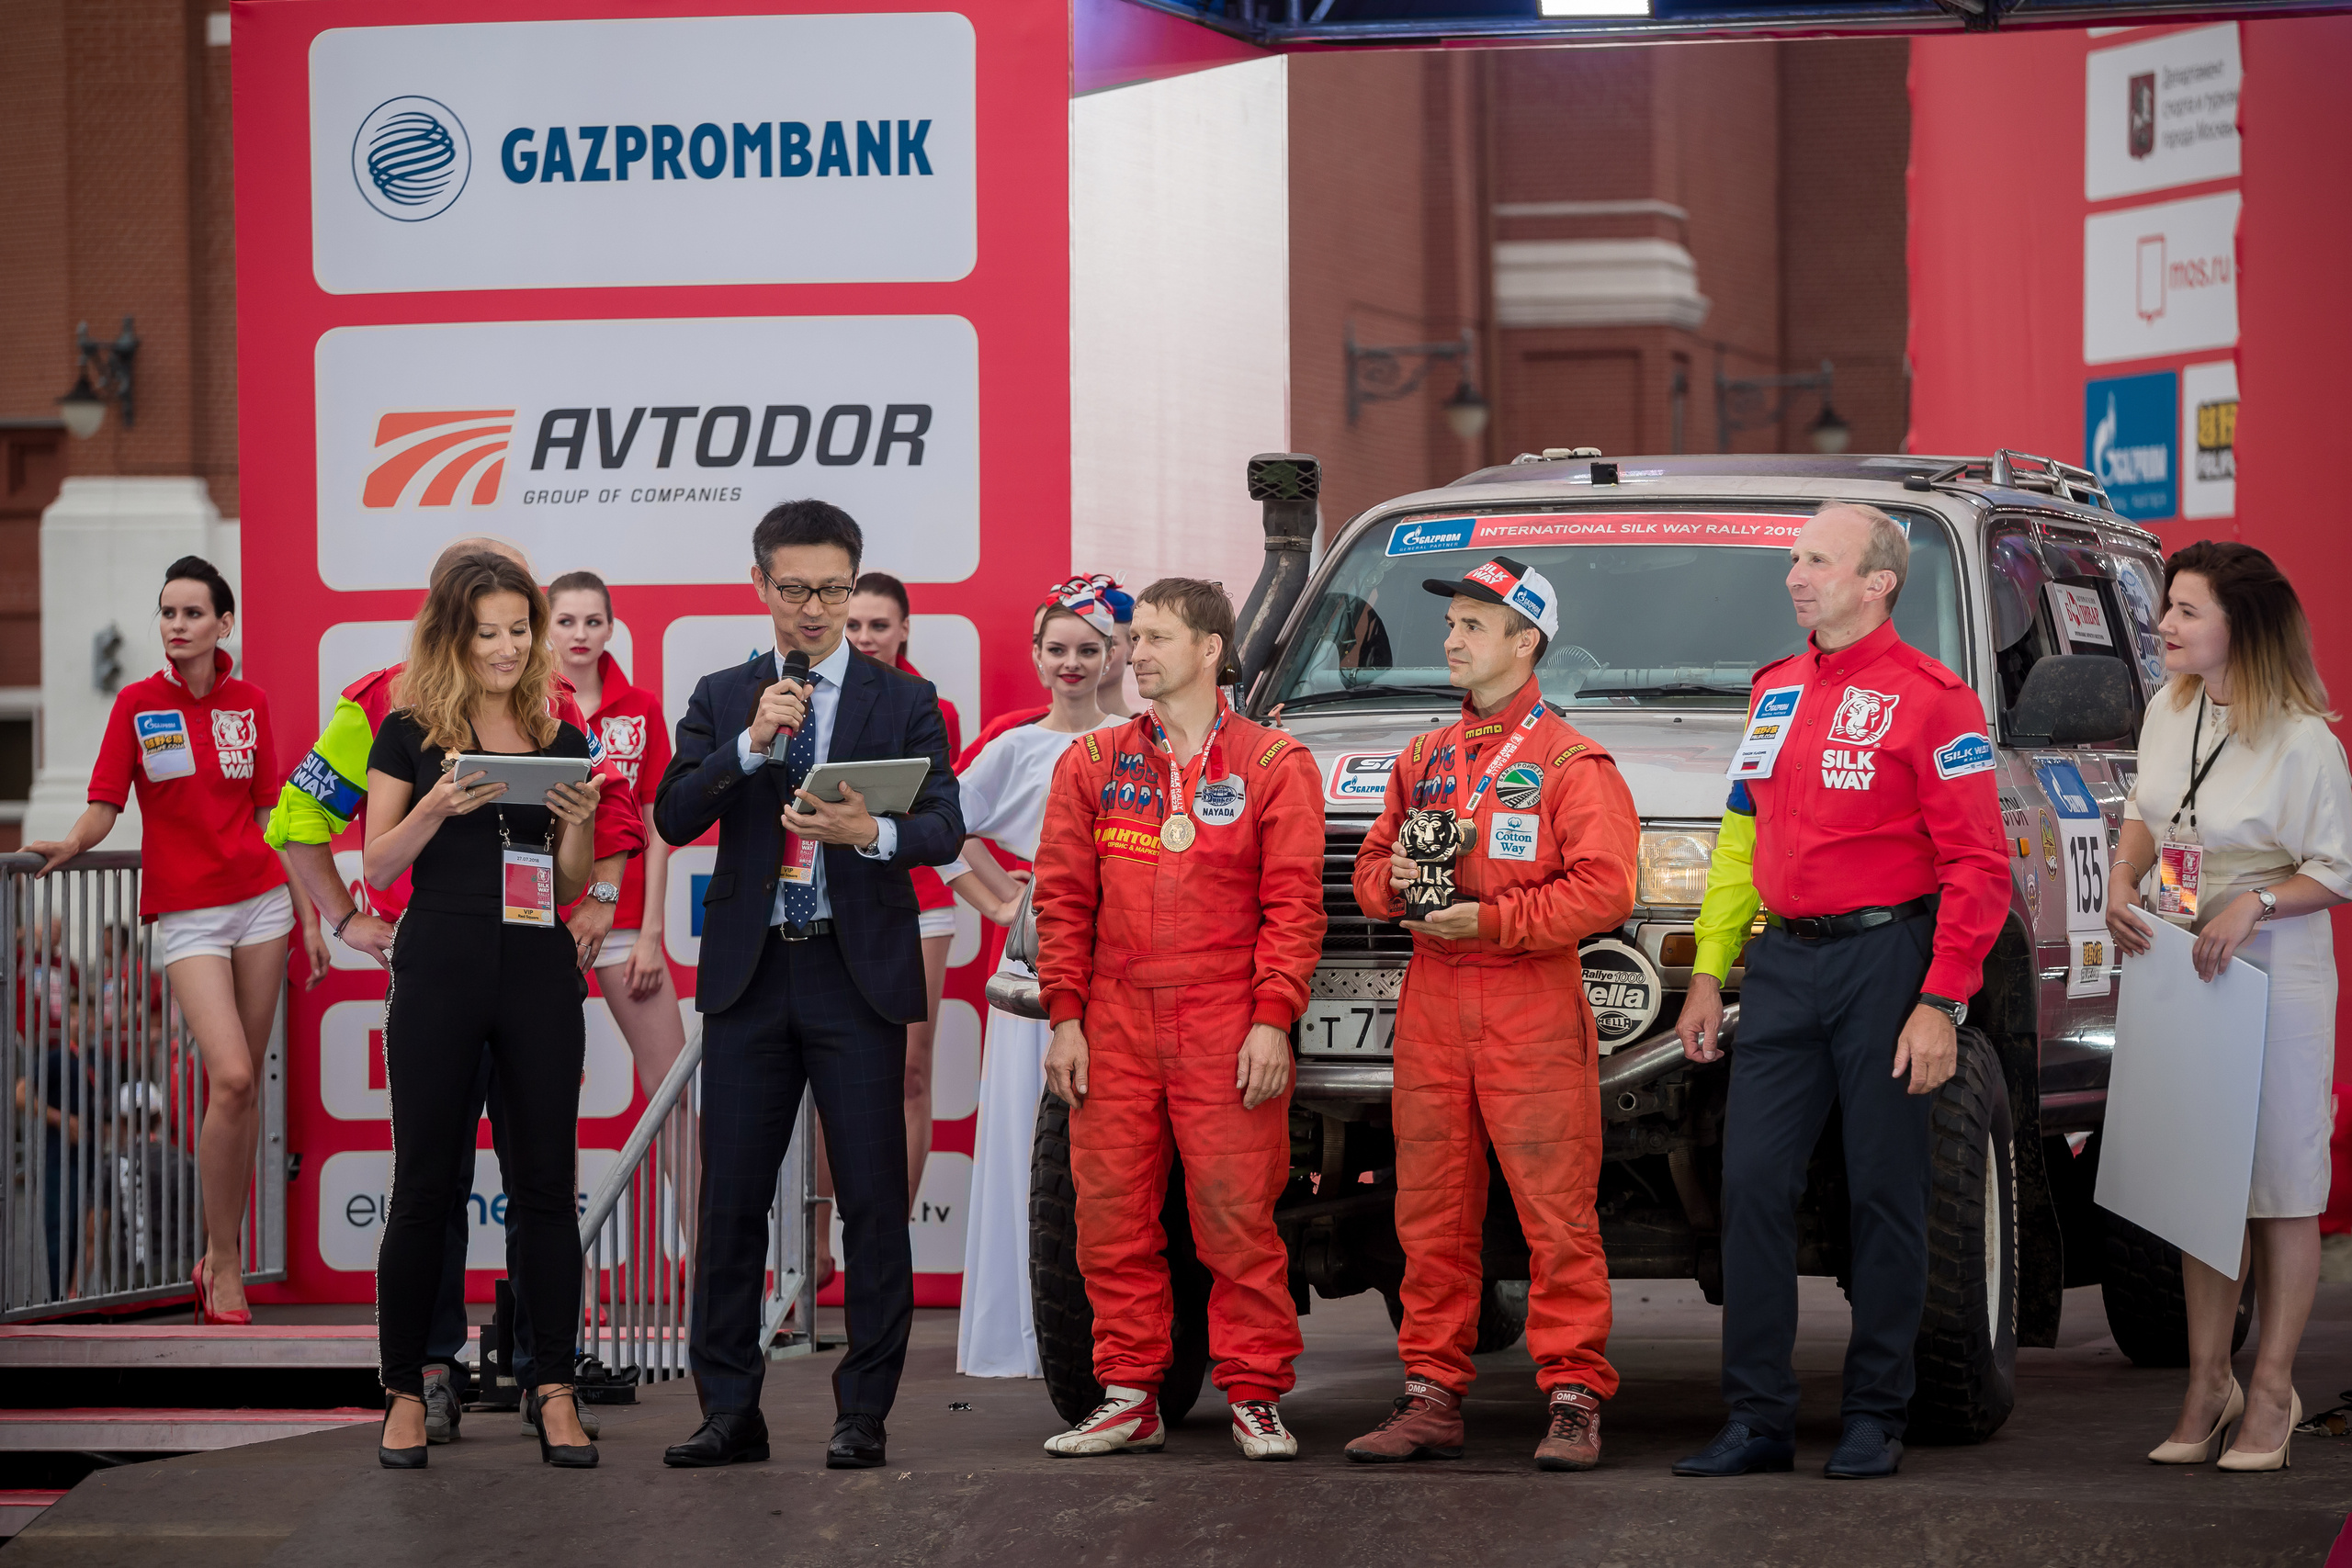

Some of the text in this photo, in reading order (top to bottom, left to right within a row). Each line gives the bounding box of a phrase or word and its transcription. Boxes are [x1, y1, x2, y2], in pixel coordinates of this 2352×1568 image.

[502, 120, 933, 184] GAZPROMBANK
[2169, 255, 2231, 289] mos.ru
[531, 404, 933, 470] AVTODOR
[524, 487, 742, 505] GROUP OF COMPANIES
[1479, 524, 1802, 537] INTERNATIONAL SILK WAY RALLY 2018
[1418, 533, 1462, 545] GAZPROM
[1472, 570, 1503, 585] WAY
[1479, 563, 1510, 581] SILK
[1822, 749, 1876, 771] SILK
[1943, 747, 1973, 763] SILK
[302, 752, 339, 791] SILK
[613, 761, 639, 779] ILK
[294, 768, 334, 802] WAY
[1822, 769, 1876, 790] WAY
[1203, 807, 1235, 818] NAYADA
[1495, 830, 1532, 843] Cotton
[1500, 842, 1526, 855] Way
[516, 855, 540, 863] 27.07.2018
[2070, 836, 2103, 914] 135
[2182, 874, 2197, 883] SILK
[2182, 881, 2197, 889] WAY
[1405, 886, 1455, 906] WAY
[1581, 969, 1645, 984] Rallye 1000
[1598, 1017, 1631, 1029] HELLA
[1408, 1383, 1427, 1393] OMP
[1556, 1393, 1577, 1402] OMP
